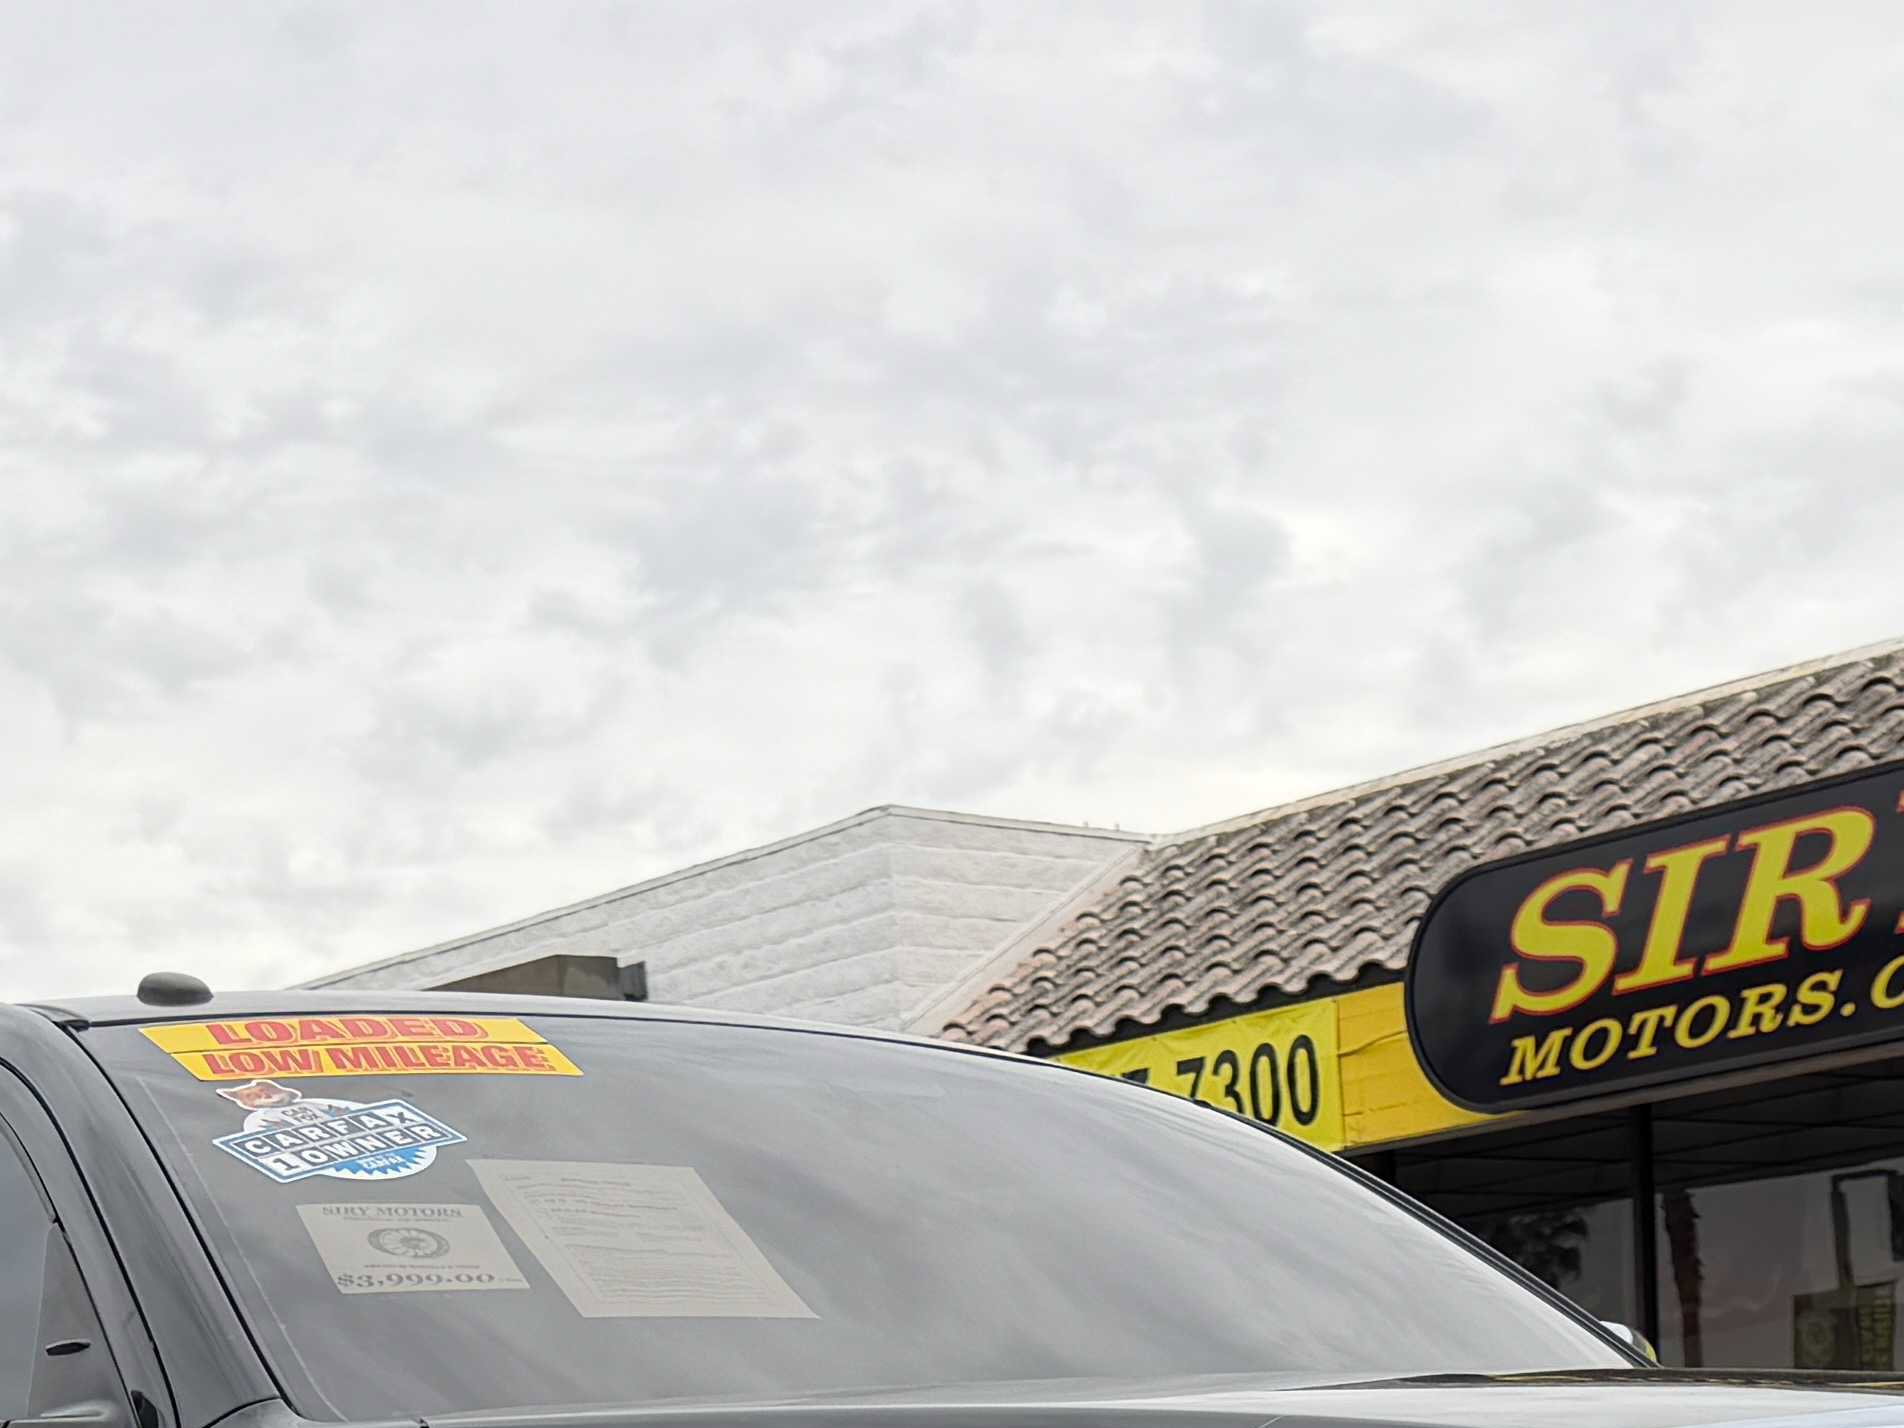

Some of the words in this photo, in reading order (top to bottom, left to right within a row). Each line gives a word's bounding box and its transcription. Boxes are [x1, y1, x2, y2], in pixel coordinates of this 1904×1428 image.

[207, 1017, 488, 1046] LOADED
[206, 1049, 322, 1075] LOW
[324, 1044, 556, 1073] MILEAGE
[244, 1111, 417, 1154] CARFAX
[301, 1125, 442, 1163] OWNER
[322, 1206, 370, 1217] SIRY
[375, 1207, 464, 1218] MOTORS
